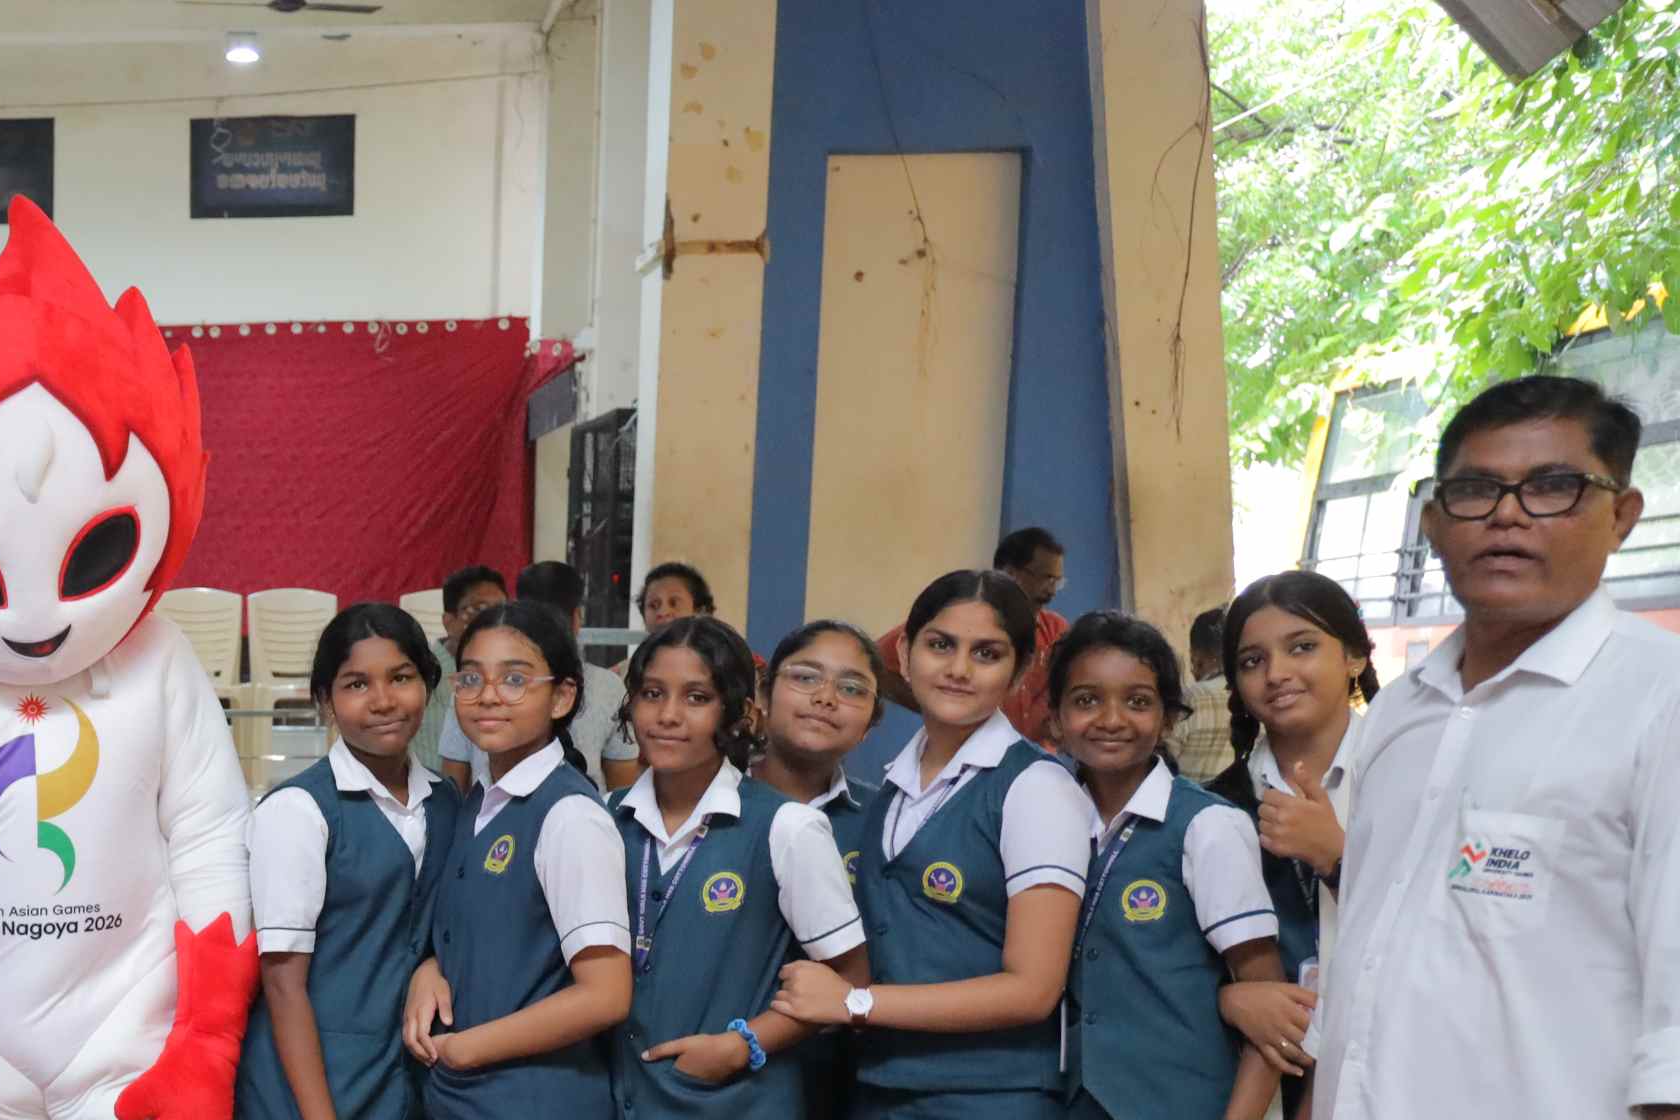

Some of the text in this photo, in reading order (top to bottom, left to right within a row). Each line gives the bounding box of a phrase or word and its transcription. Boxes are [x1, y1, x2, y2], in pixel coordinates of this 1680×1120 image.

[1490, 847, 1531, 860] KHELO
[1485, 858, 1520, 870] INDIA
[9, 904, 48, 917] Asian
[52, 904, 101, 916] Games
[84, 913, 122, 932] 2026
